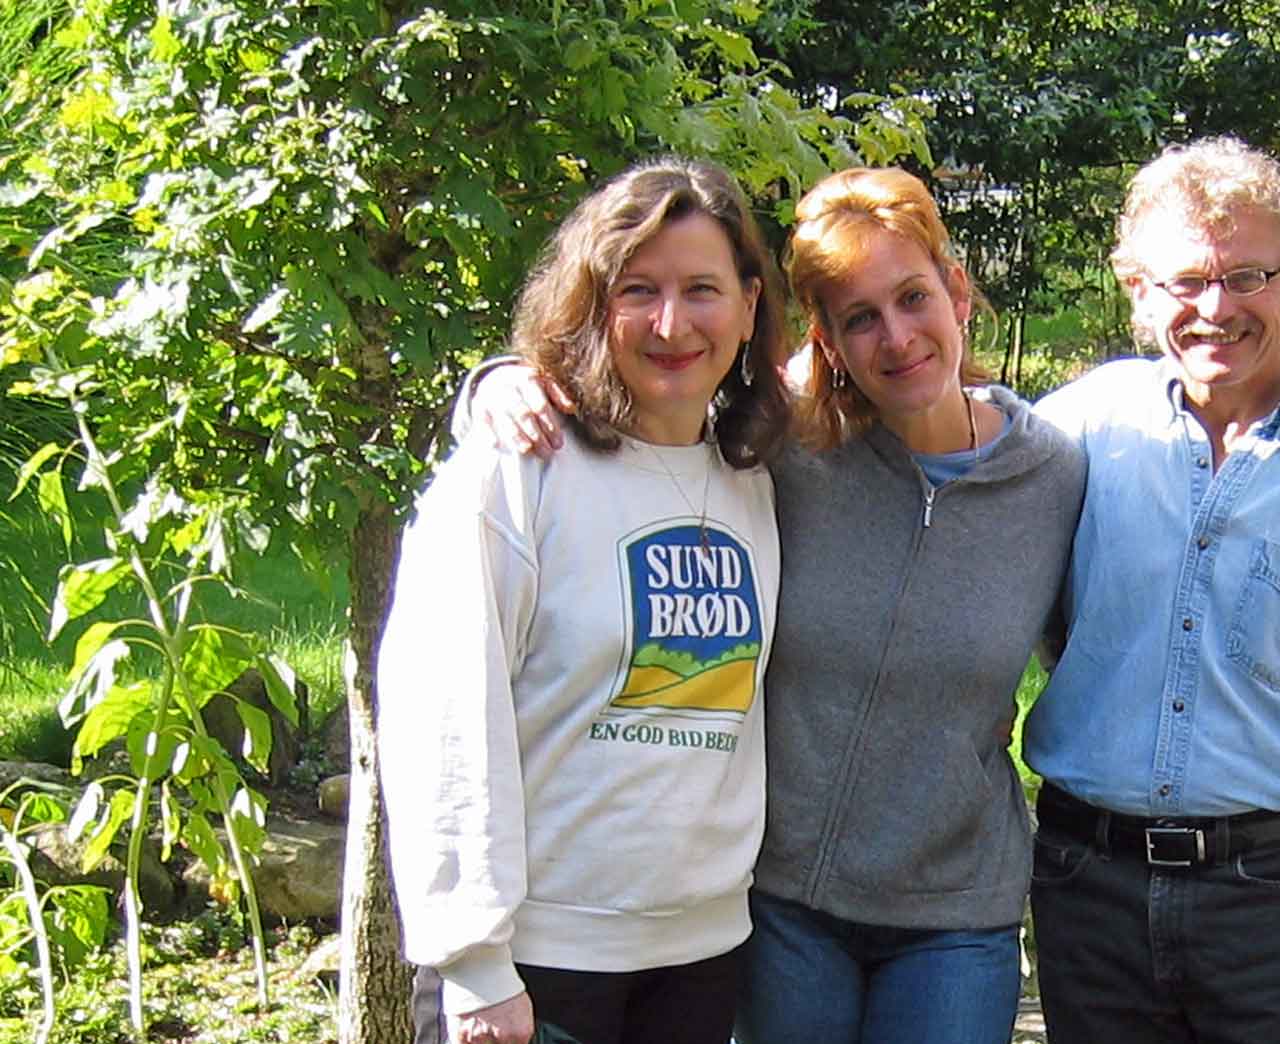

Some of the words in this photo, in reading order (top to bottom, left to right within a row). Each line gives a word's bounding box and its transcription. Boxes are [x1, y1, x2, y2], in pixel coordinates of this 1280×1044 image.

[646, 544, 742, 589] SUND
[648, 592, 751, 639] BRØD
[589, 721, 620, 741] EN
[622, 724, 664, 745] GOD
[668, 728, 703, 748] BID
